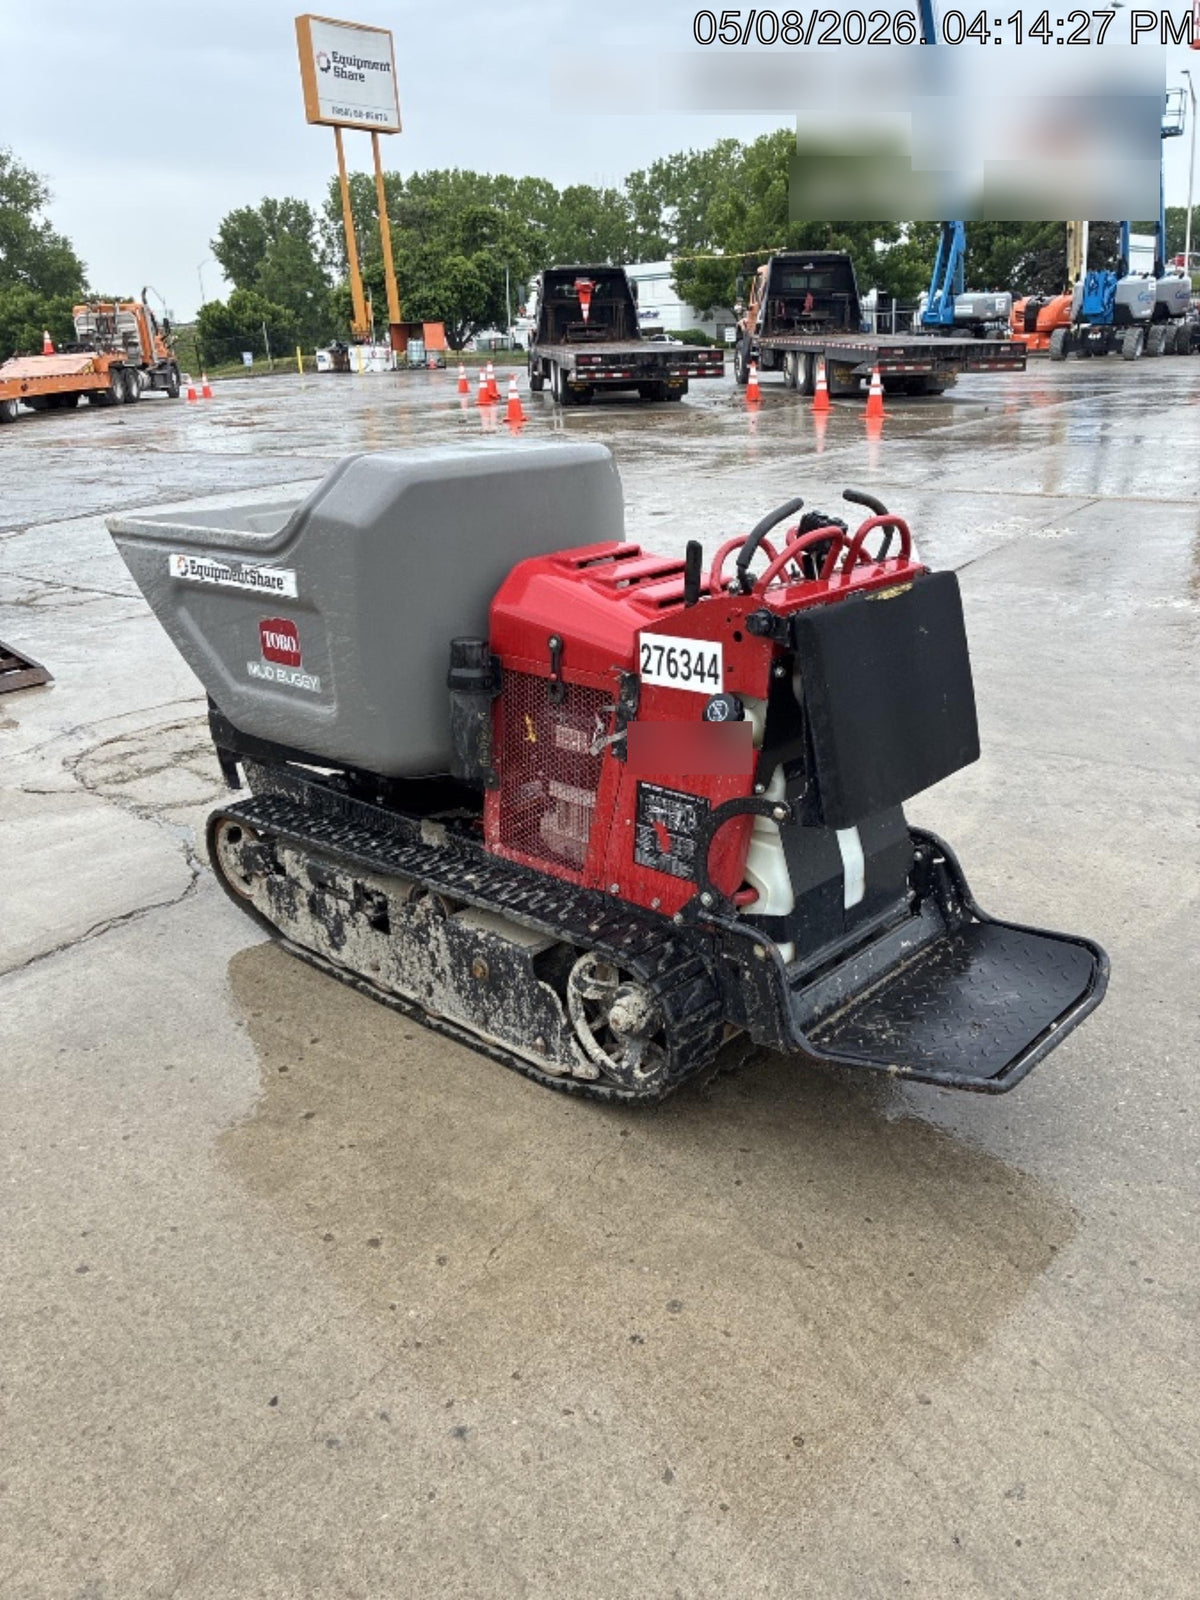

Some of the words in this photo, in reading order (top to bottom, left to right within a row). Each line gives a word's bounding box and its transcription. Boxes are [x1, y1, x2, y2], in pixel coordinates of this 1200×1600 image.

[332, 51, 391, 72] Equipment
[333, 66, 365, 82] Share
[189, 559, 285, 591] EquipmentShare
[262, 630, 297, 652] TORO
[247, 661, 274, 680] MUD
[276, 668, 319, 690] BUGGY
[640, 642, 720, 686] 276344
